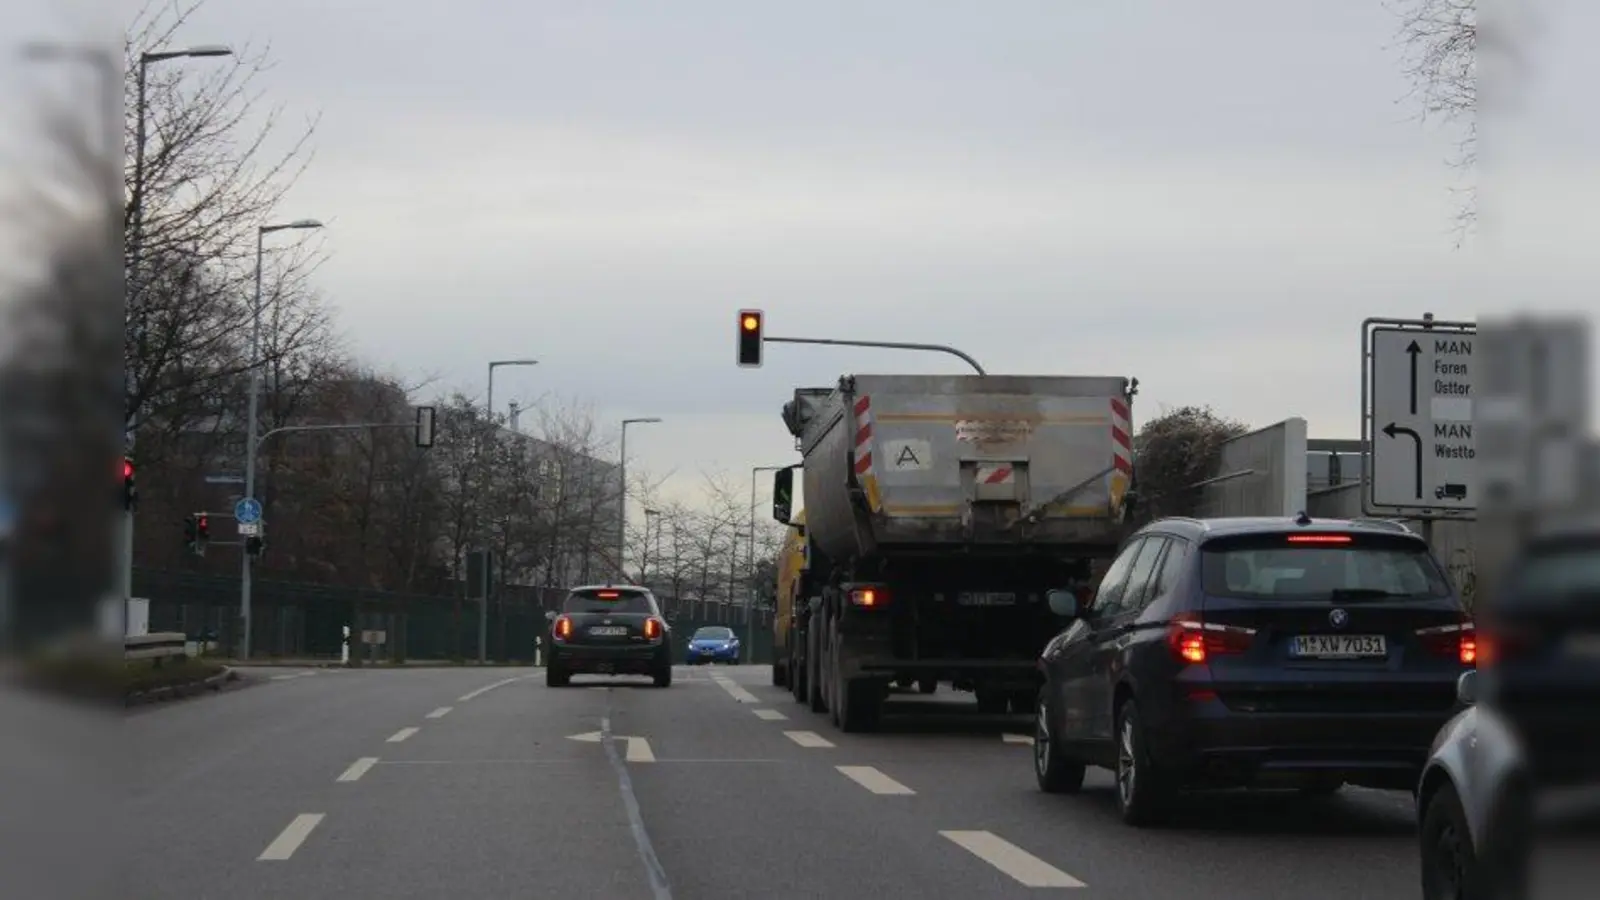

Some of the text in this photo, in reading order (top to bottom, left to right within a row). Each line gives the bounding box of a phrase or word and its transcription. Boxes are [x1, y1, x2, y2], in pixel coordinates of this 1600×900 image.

[1434, 340, 1472, 355] MAN
[1434, 359, 1468, 375] Foren
[1434, 379, 1471, 394] Osttor
[1434, 423, 1472, 439] MAN
[896, 445, 920, 466] A
